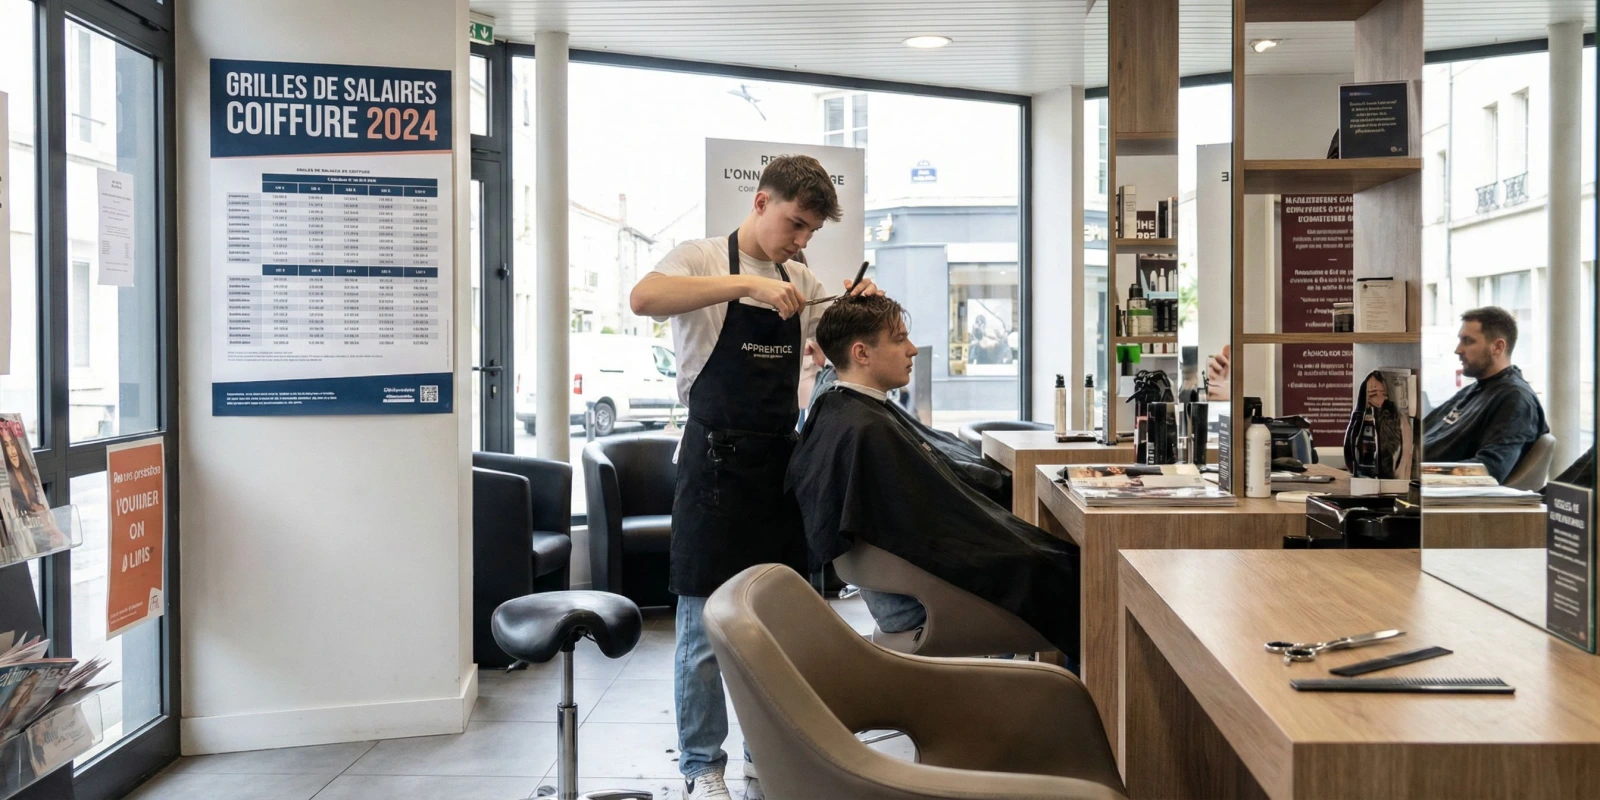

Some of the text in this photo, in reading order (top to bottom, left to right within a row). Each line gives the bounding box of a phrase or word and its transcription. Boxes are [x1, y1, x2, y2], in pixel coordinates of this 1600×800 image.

[226, 71, 437, 105] GRILLES DE SALAIRES
[226, 101, 438, 141] COIFFURE 2024
[129, 520, 145, 540] ON
